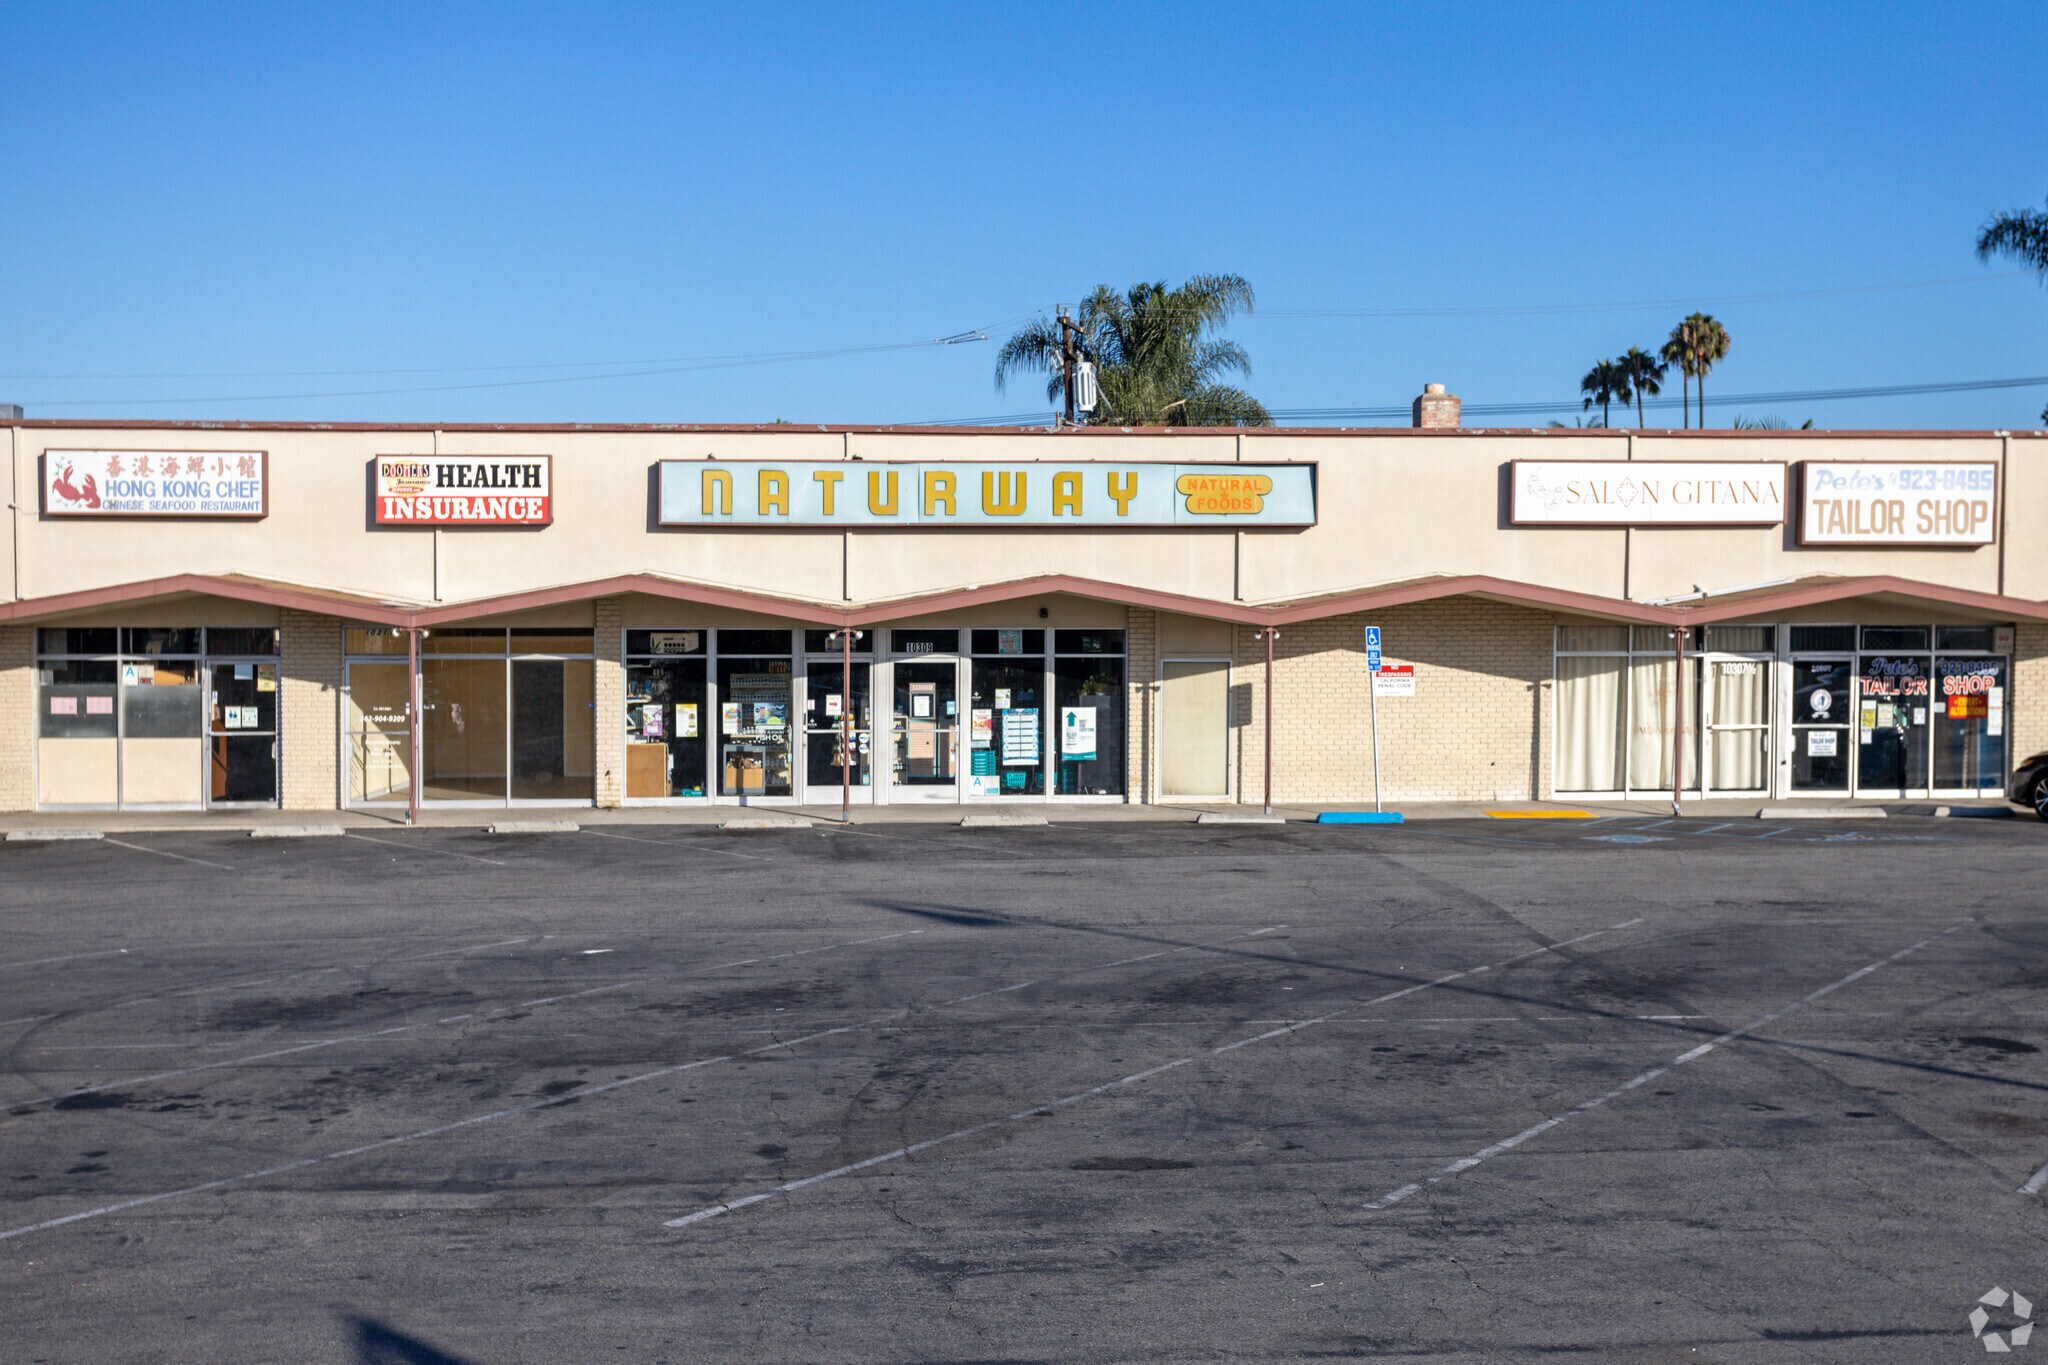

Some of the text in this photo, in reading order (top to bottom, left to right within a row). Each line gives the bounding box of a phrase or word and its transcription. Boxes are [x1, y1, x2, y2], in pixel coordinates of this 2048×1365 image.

[381, 463, 430, 478] BOOMERS
[435, 464, 542, 488] HEALTH
[1813, 469, 1885, 491] Pete's
[1899, 469, 1993, 491] 923-8495
[105, 480, 260, 499] HONG KONG CHEF
[701, 469, 1139, 517] NATURWAY
[1187, 479, 1263, 491] NATURAL
[1672, 480, 1780, 505] GITANA
[102, 500, 260, 512] CHINESE SEAFOOD RESTAURANT
[383, 497, 543, 520] INSURANCE
[1197, 498, 1253, 511] FOODS
[1812, 498, 1989, 535] TAILOR SHOP
[906, 642, 933, 653] 10309
[126, 667, 134, 677] A
[1721, 662, 1748, 676] 10307
[1869, 657, 1918, 676] Pete's
[1861, 675, 1995, 696] TAILOR SHOP
